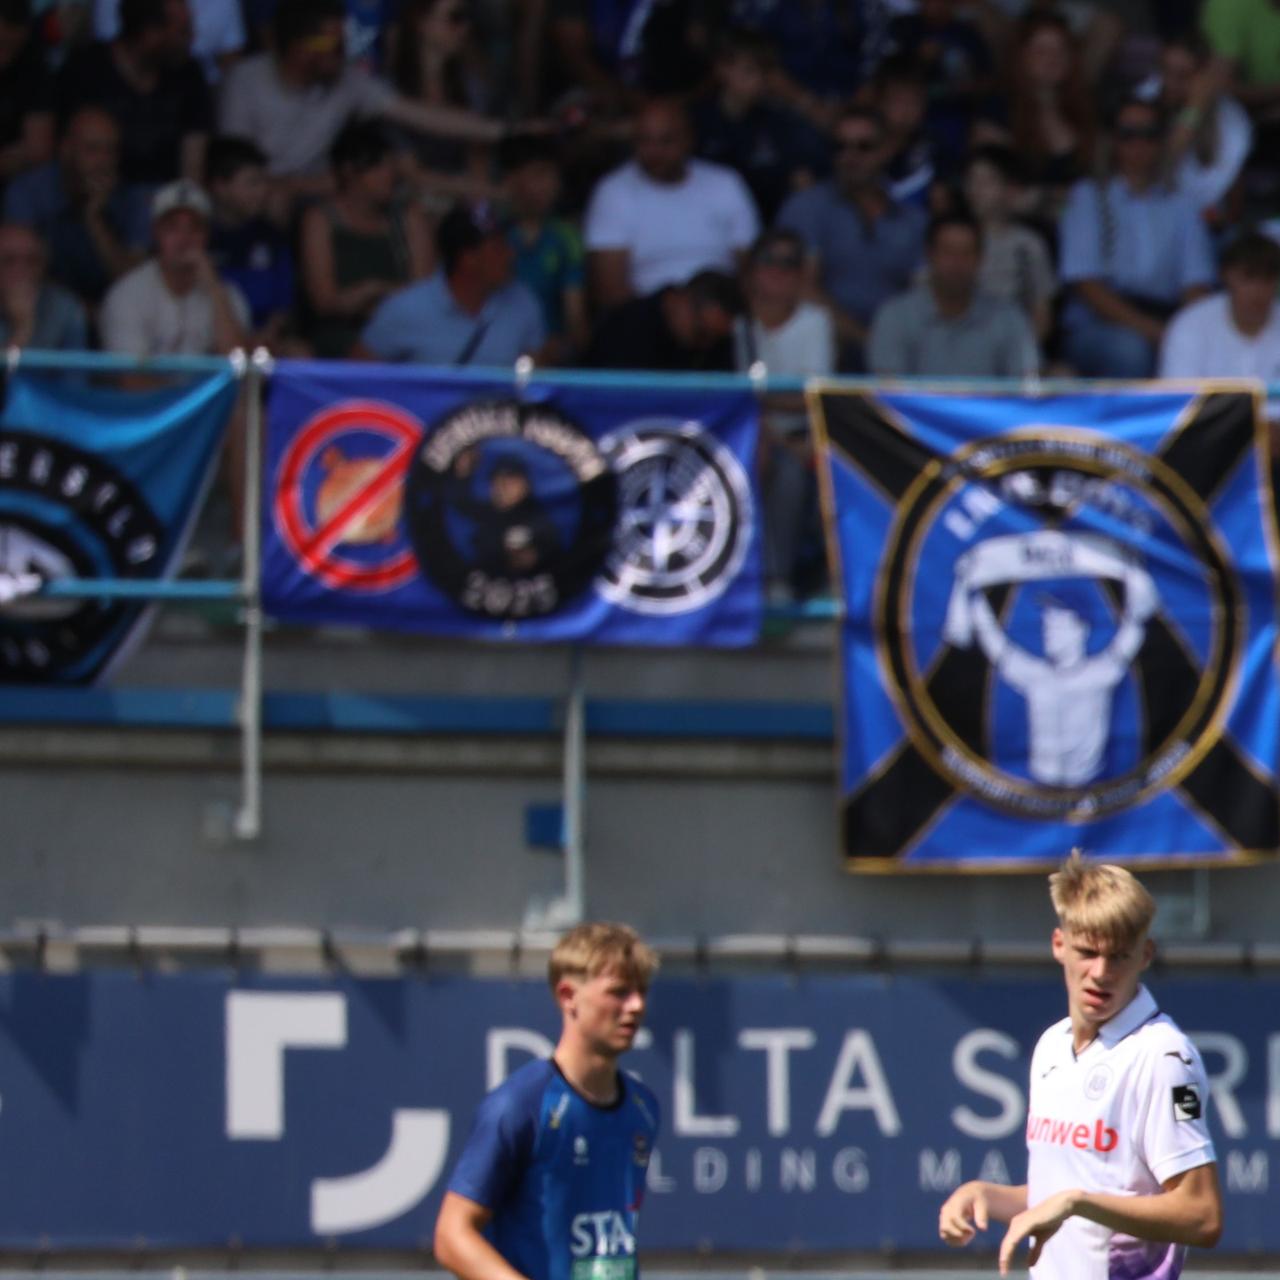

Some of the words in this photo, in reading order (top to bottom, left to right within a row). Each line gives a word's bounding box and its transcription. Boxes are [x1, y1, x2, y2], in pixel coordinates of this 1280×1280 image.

[485, 1028, 904, 1139] DLTA
[1027, 1118, 1119, 1153] unweb
[646, 1147, 870, 1194] LDING
[569, 1209, 638, 1258] STA
